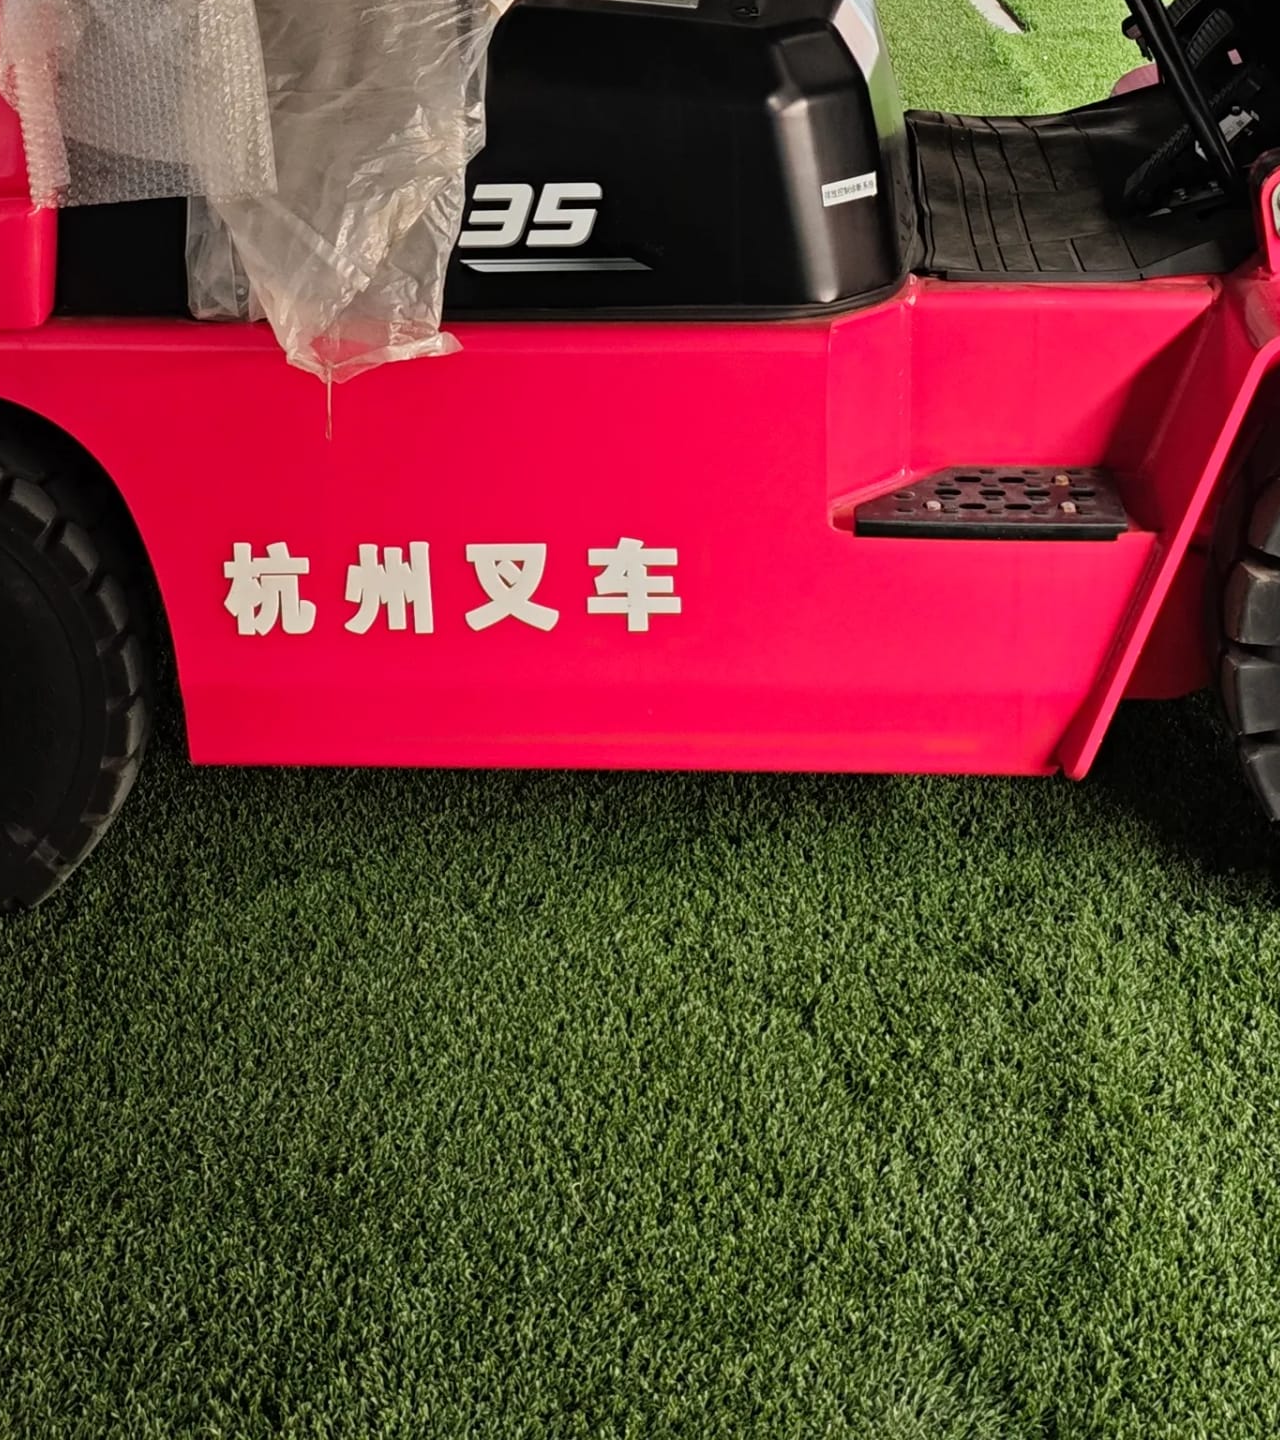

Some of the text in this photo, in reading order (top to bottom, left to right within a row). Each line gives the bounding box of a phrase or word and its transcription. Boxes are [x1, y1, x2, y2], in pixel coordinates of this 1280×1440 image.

[458, 182, 603, 247] 35
[223, 536, 682, 636] 杭州叉车
